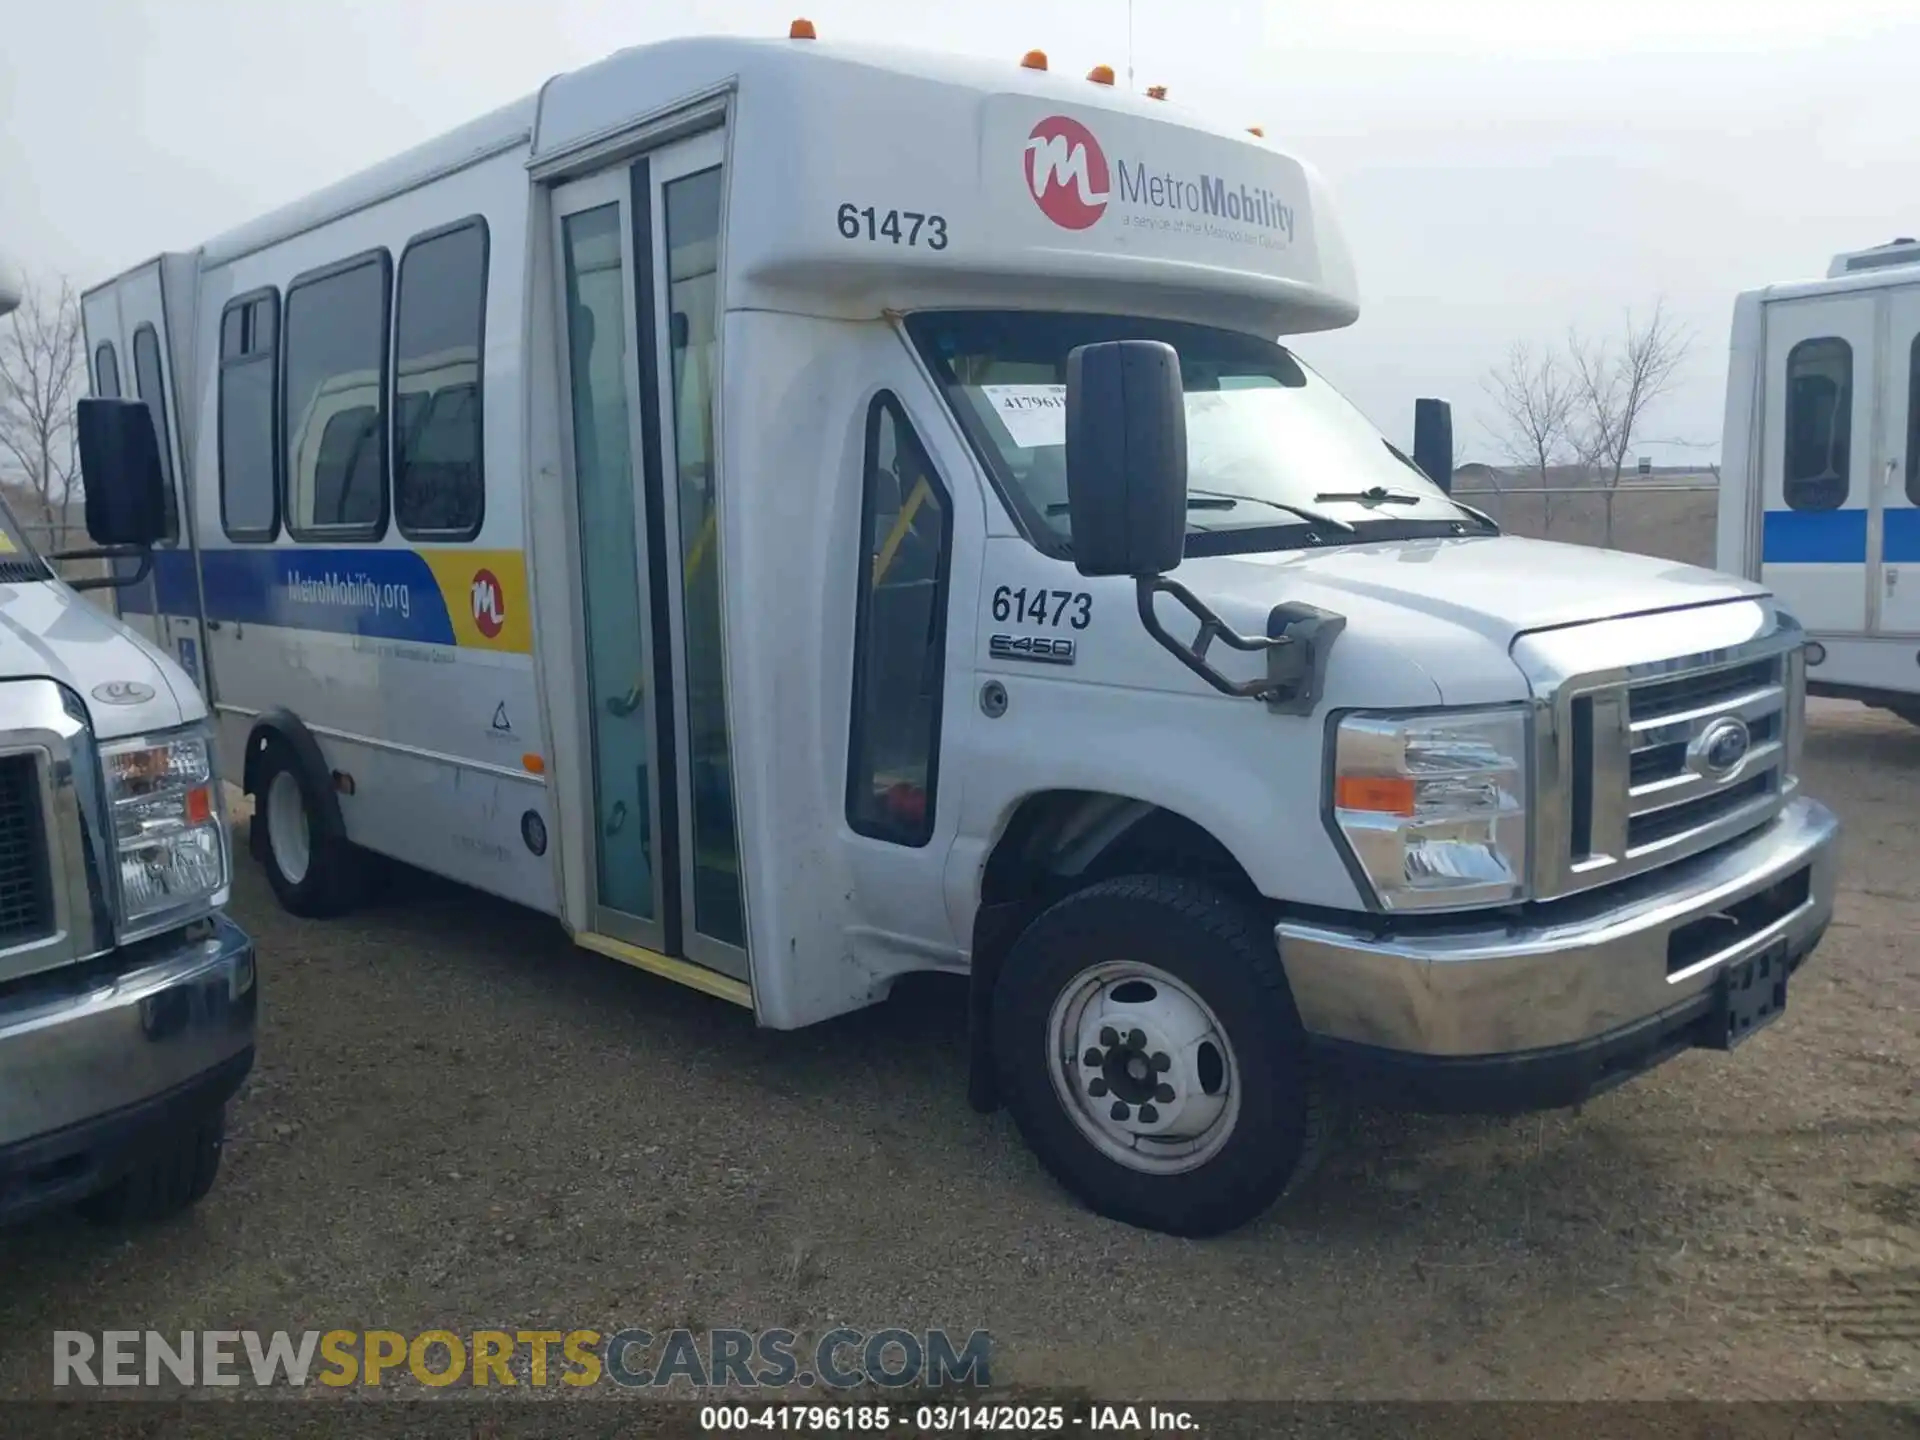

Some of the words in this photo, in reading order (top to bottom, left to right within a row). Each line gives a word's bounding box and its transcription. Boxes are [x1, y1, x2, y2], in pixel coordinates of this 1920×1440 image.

[1118, 159, 1294, 243] MetroMobility
[837, 203, 948, 250] 61473
[287, 569, 410, 618] MetroMobility.org
[992, 585, 1093, 630] 61473
